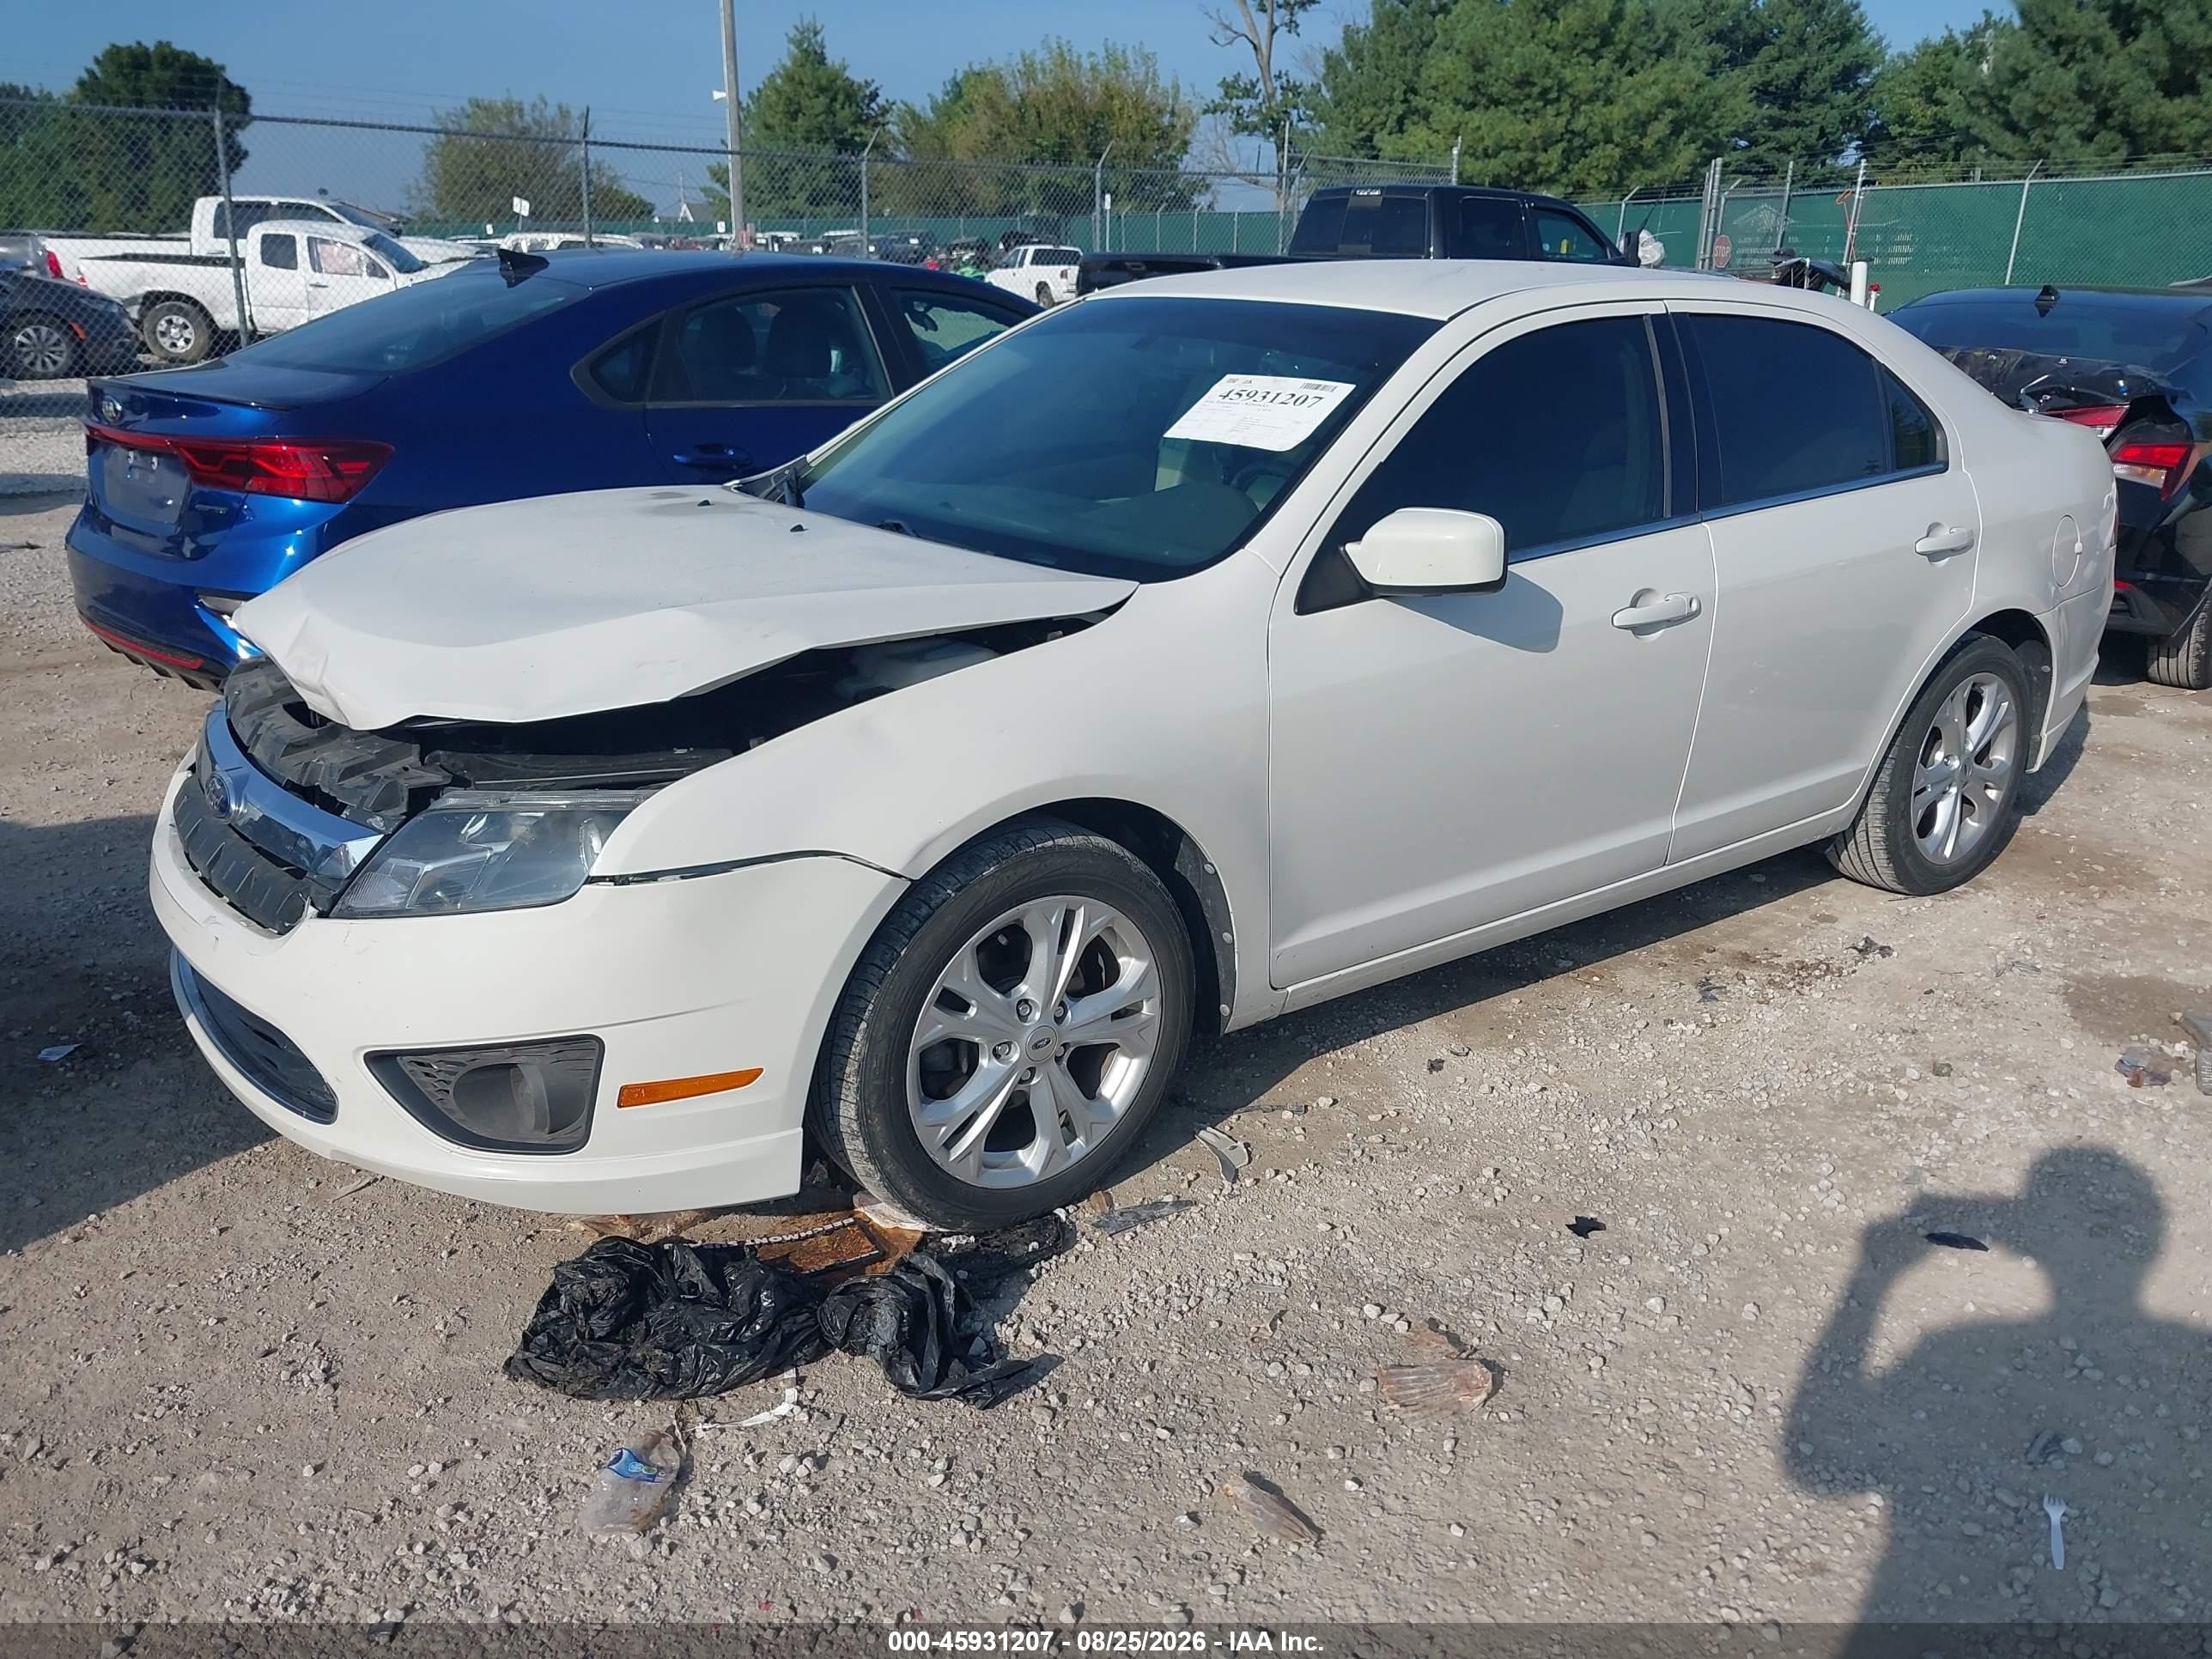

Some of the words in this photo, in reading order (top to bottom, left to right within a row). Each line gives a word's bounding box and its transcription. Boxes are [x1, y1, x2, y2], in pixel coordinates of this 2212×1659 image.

[1714, 246, 1730, 258] STOP
[1218, 388, 1324, 409] 45931207
[744, 1217, 854, 1247] BEECHMONT
